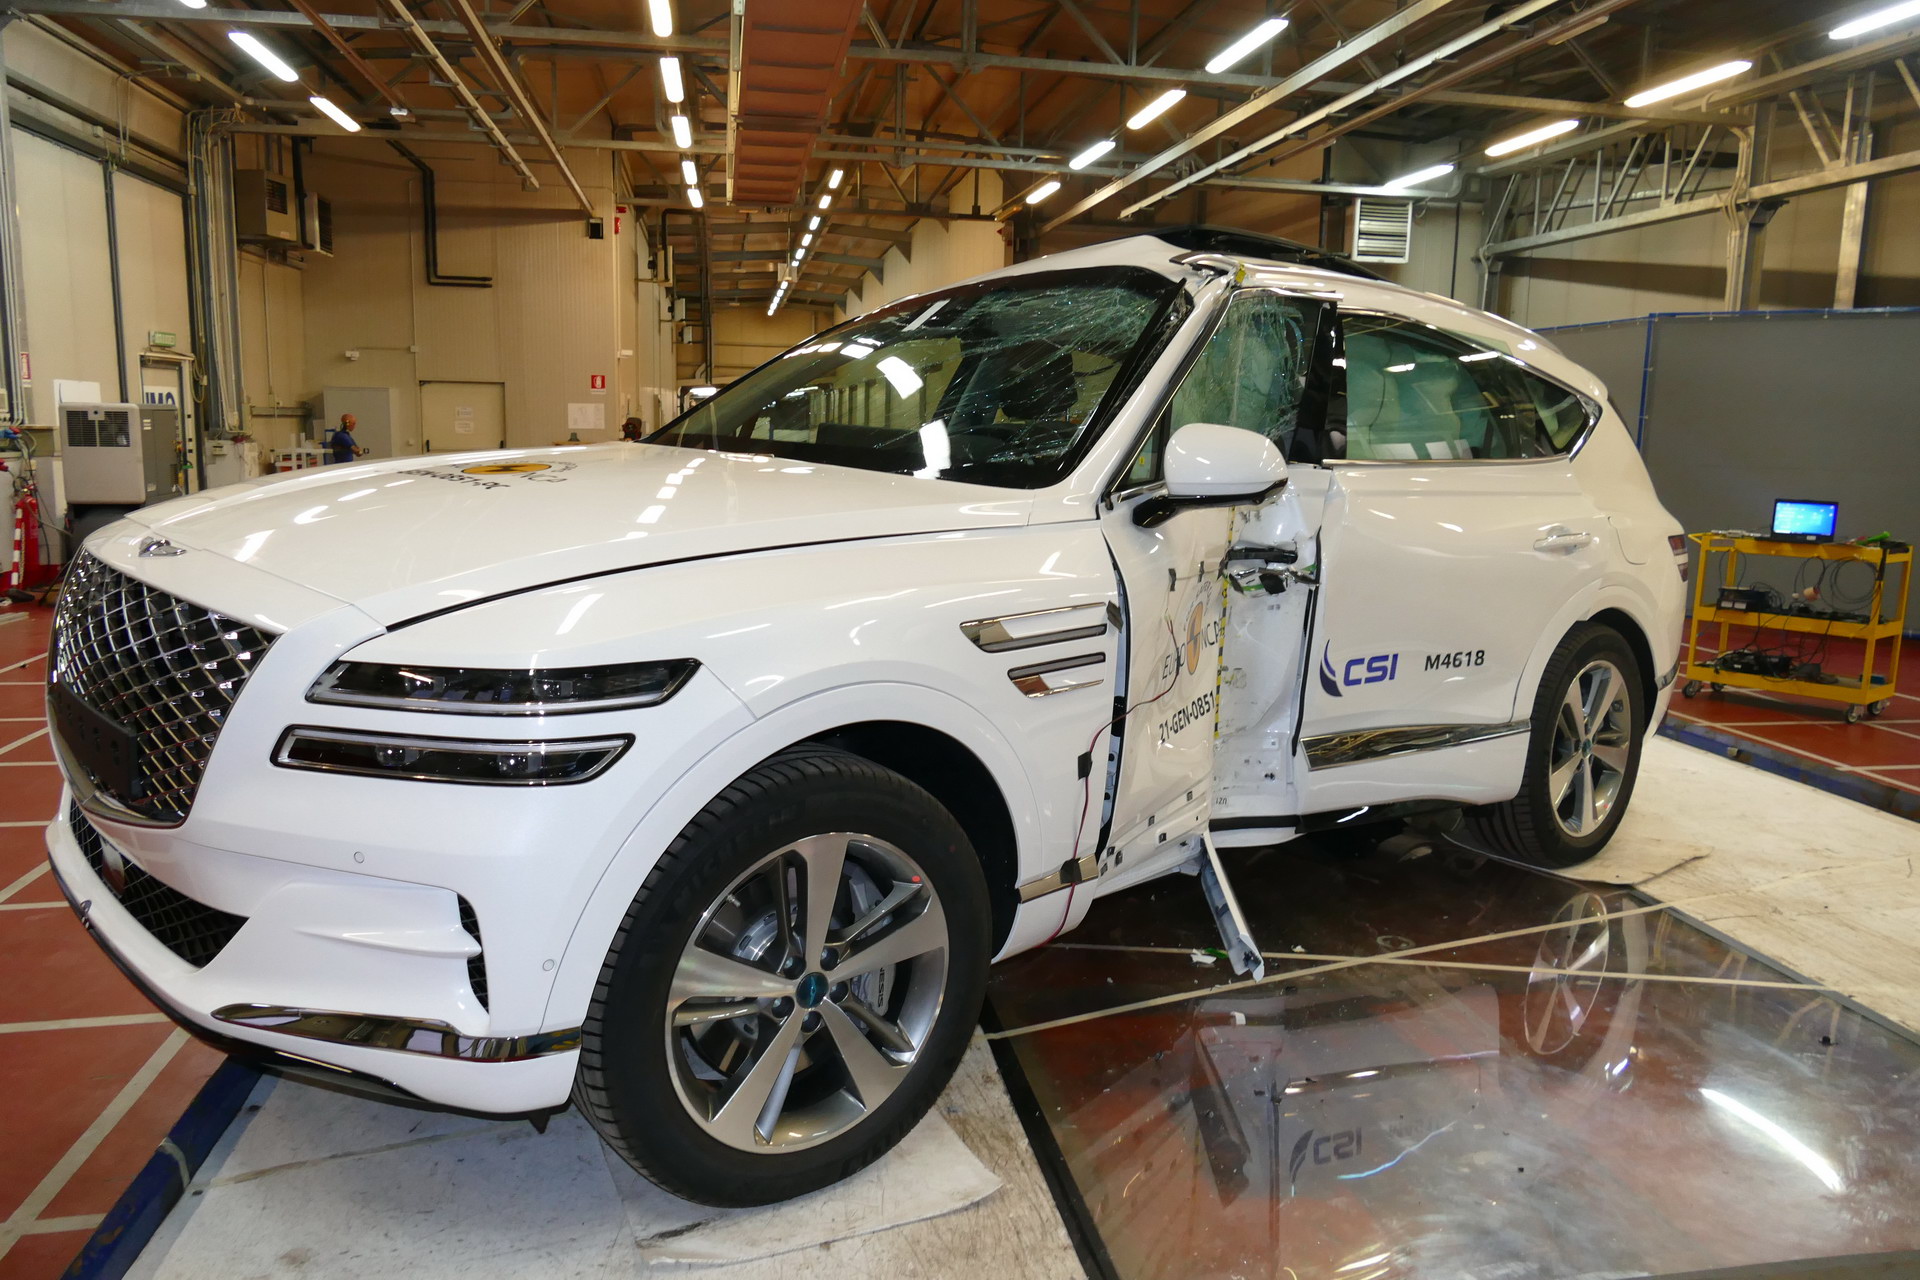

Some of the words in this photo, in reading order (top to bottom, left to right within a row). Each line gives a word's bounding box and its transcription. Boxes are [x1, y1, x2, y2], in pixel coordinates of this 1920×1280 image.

[1162, 643, 1186, 680] EUO
[1343, 653, 1399, 687] CSI
[1424, 650, 1485, 671] M4618
[1159, 690, 1215, 745] 21-GEN-0851
